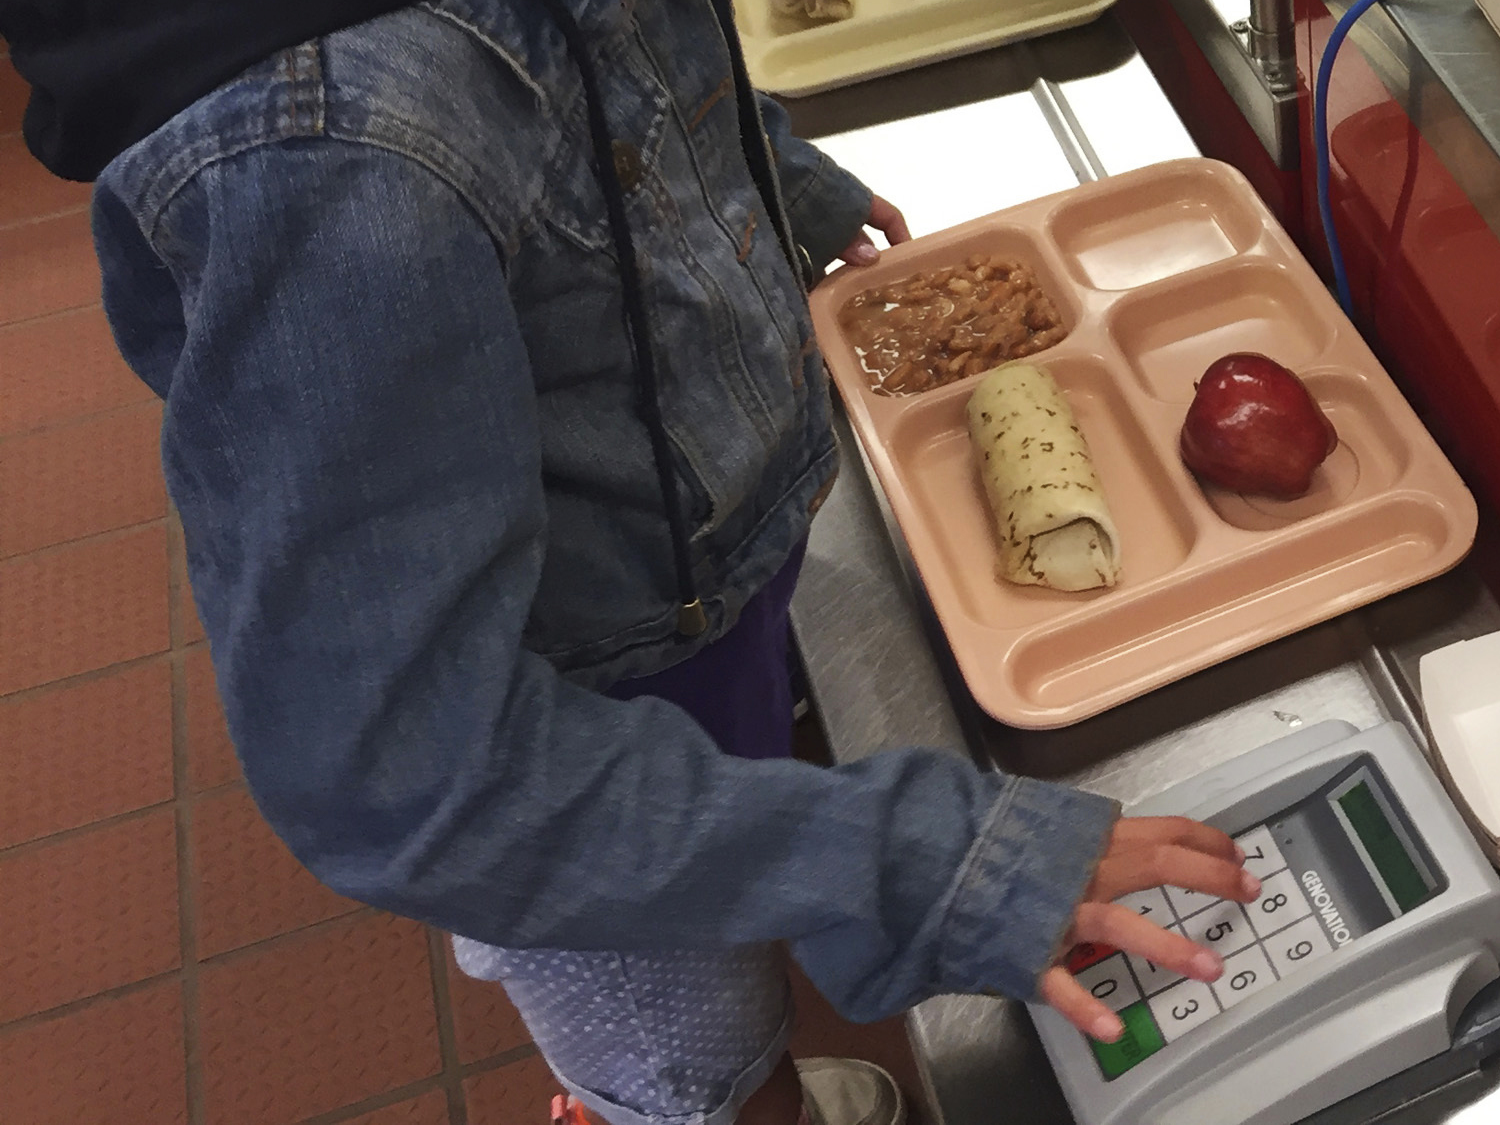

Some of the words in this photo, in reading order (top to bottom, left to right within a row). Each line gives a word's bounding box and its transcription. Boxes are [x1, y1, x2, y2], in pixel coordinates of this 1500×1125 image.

[1244, 845, 1265, 860] 7
[1261, 893, 1288, 914] 8
[1204, 920, 1234, 943] 5
[1286, 940, 1314, 961] 9
[1090, 978, 1118, 999] 0
[1229, 970, 1257, 991] 6
[1172, 999, 1199, 1021] 3
